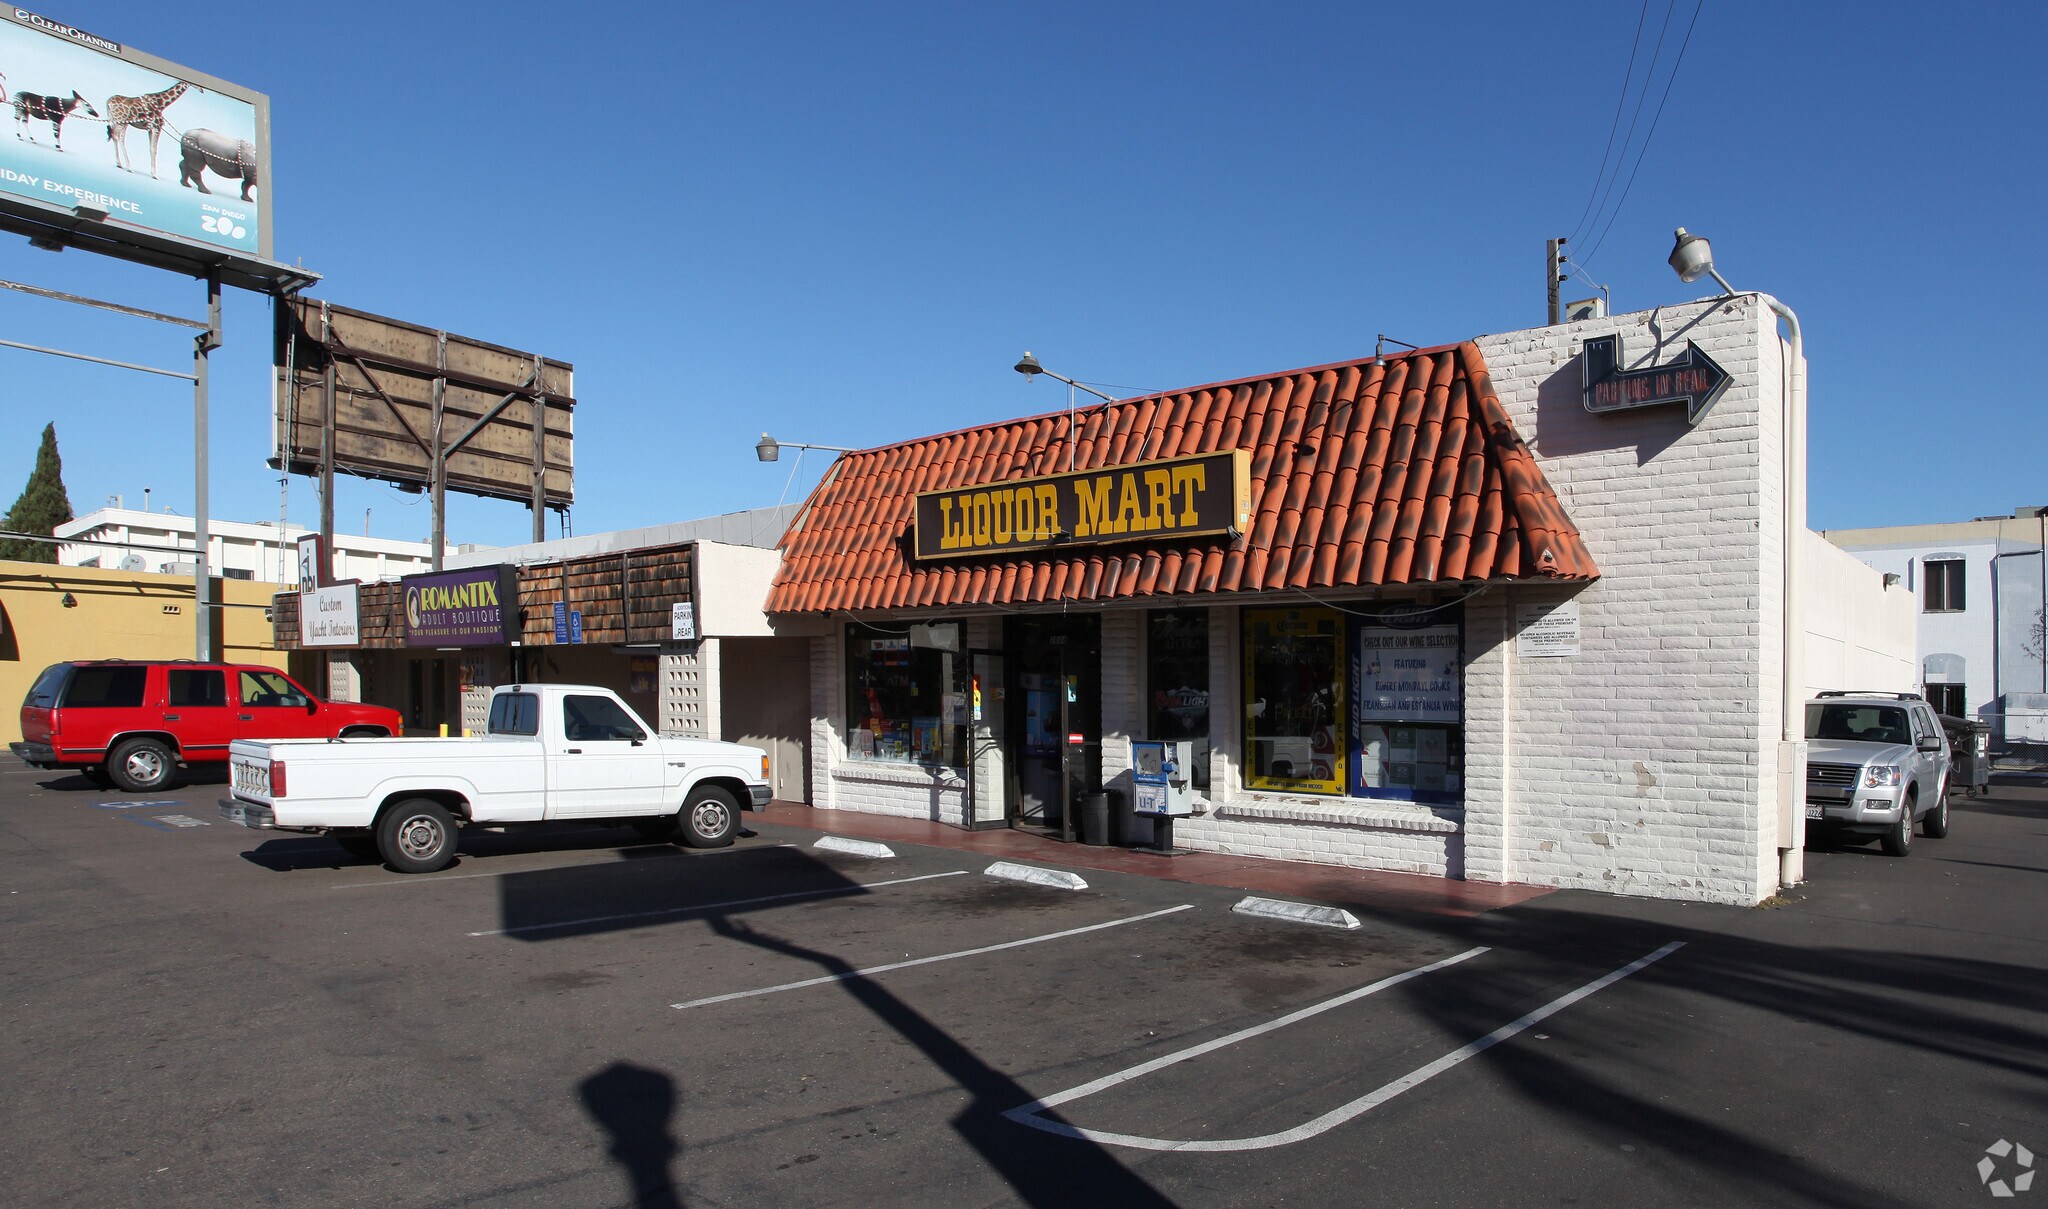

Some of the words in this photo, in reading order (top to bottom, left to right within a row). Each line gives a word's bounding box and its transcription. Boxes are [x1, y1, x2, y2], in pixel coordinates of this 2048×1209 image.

[43, 179, 144, 215] EXPERIENCE.
[201, 203, 220, 213] SAN
[221, 208, 246, 221] DIEGO
[1656, 373, 1670, 397] IN
[1675, 368, 1708, 393] REAR
[940, 483, 1061, 550] LIQUOR
[1074, 463, 1206, 538] MART
[319, 595, 342, 612] Custom
[420, 580, 499, 611] ROMANTIX
[422, 613, 446, 626] ADULT
[452, 608, 501, 625] BOUTIQUE
[674, 611, 692, 621] PARKIN
[308, 620, 327, 643] Yacht
[329, 619, 356, 638] Interiors
[425, 627, 450, 636] PLEASURE
[452, 627, 457, 635] IS
[459, 627, 471, 635] OUR
[677, 627, 692, 637] REAR
[1364, 636, 1380, 647] CHECK
[1381, 636, 1394, 647] OUT
[1395, 636, 1408, 647] OUR
[1409, 635, 1425, 647] WINE
[1394, 659, 1427, 670] FEATURING
[1351, 653, 1361, 699] LIGHT
[1375, 681, 1397, 691] ROBERT
[1429, 681, 1451, 691] COOKS
[1397, 701, 1410, 711] AND
[1351, 701, 1361, 740] BUD
